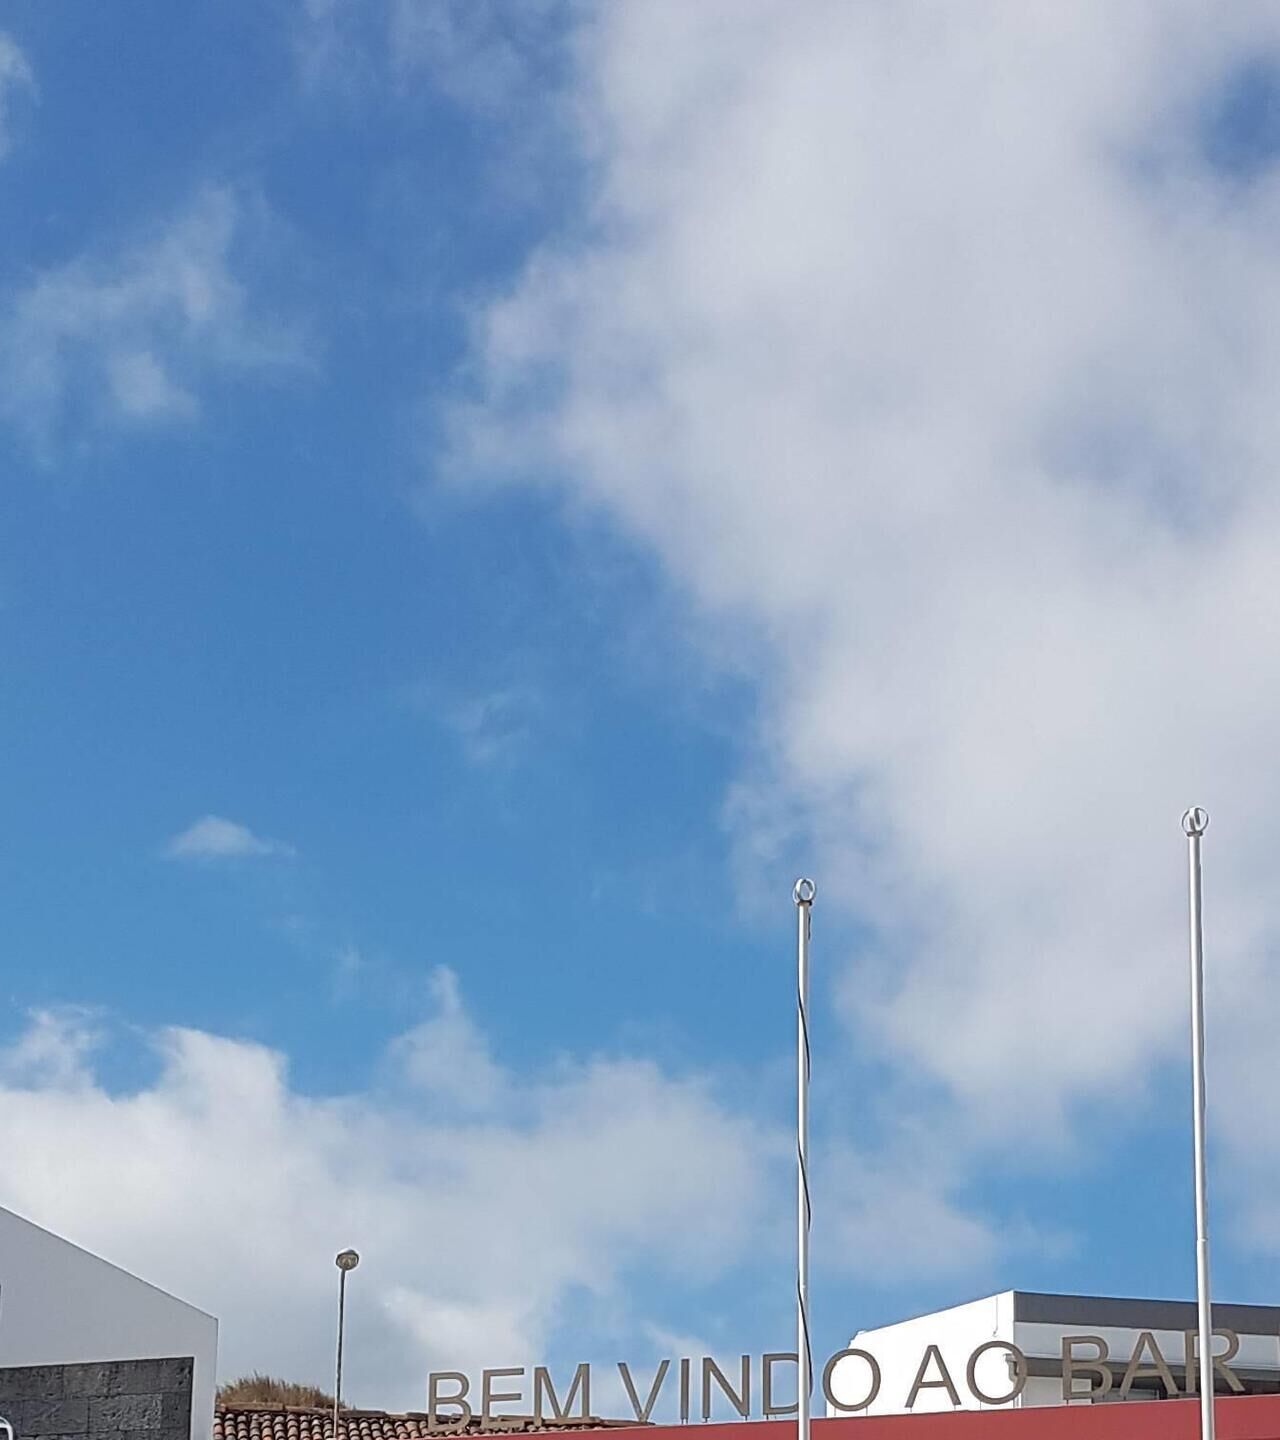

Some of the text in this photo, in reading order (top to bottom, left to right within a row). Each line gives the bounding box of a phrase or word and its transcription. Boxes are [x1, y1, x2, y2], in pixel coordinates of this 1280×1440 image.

[427, 1362, 592, 1431] BEM
[617, 1347, 882, 1424] VINDO
[905, 1340, 1028, 1408] AO
[1062, 1327, 1245, 1401] BAR
